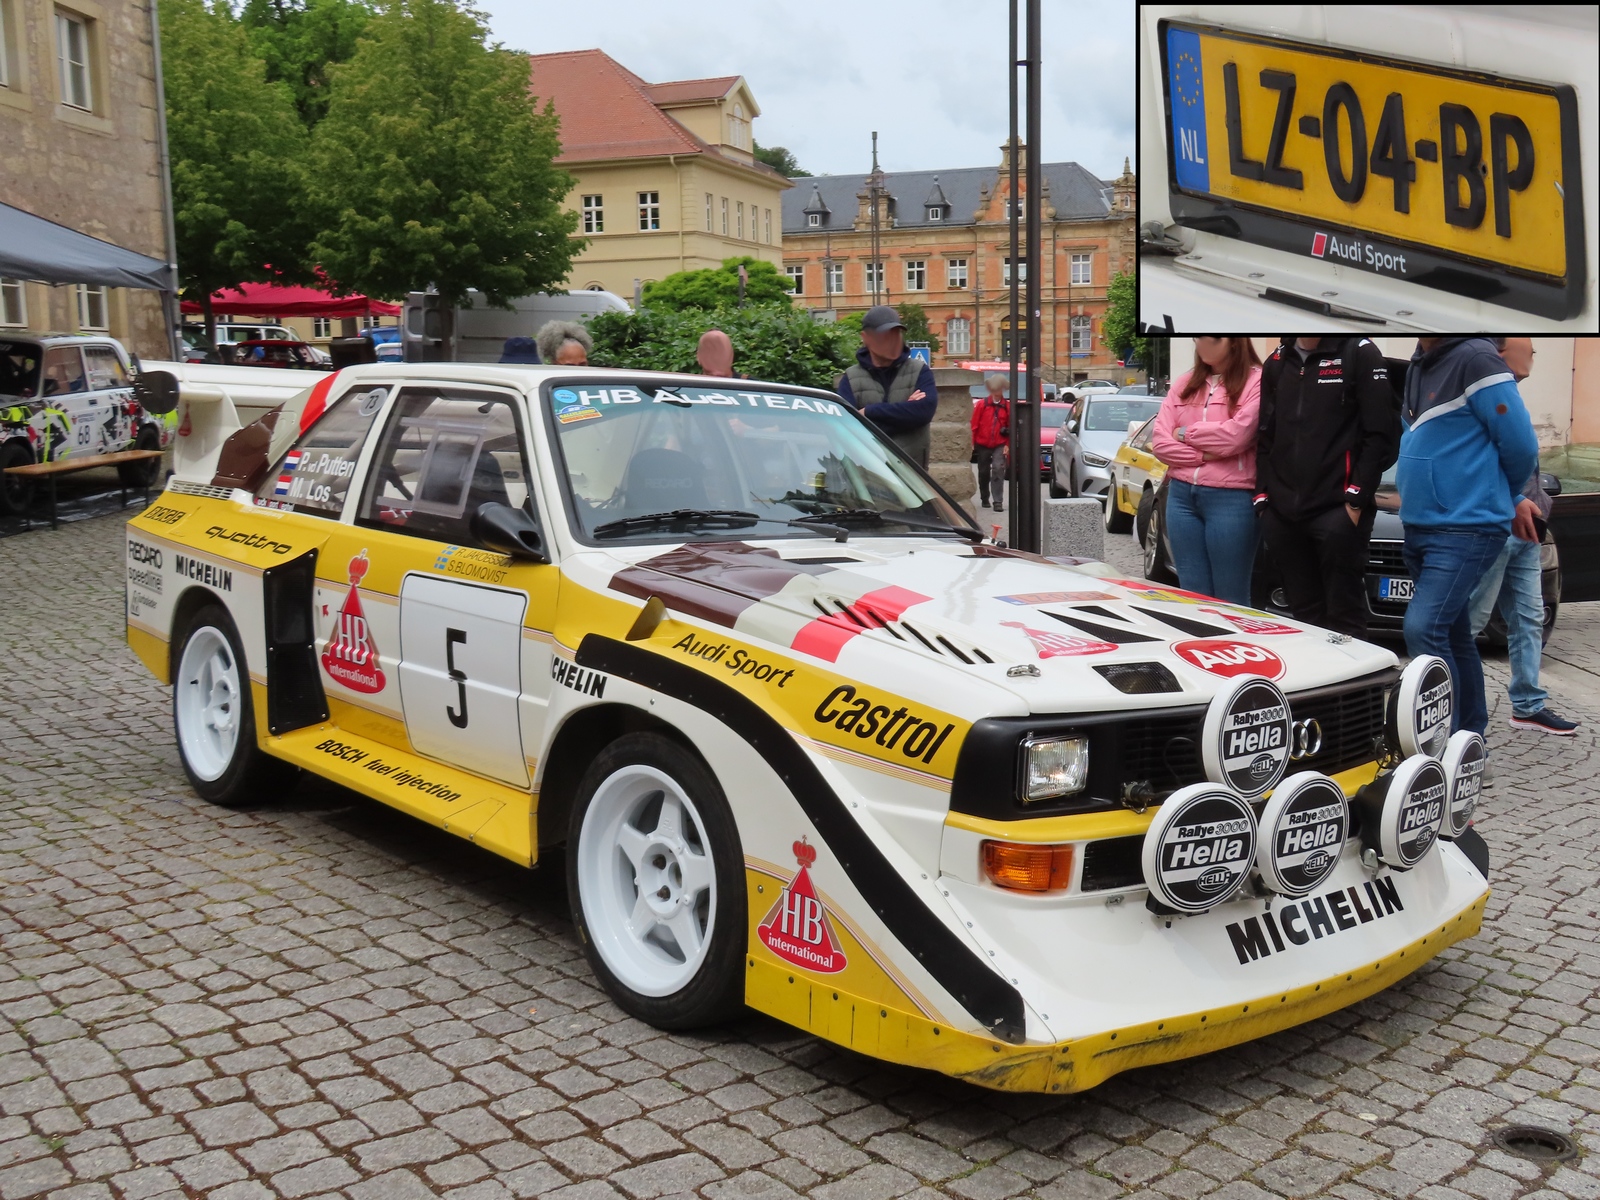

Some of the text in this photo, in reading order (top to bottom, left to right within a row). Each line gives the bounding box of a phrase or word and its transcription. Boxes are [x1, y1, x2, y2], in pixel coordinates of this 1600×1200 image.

[1180, 126, 1204, 164] NL
[1223, 62, 1535, 239] LZ-04-BP
[1329, 236, 1406, 273] Audi Sport
[365, 395, 379, 409] 73
[579, 389, 641, 405] HB
[738, 393, 842, 416] TEAM
[78, 425, 90, 445] 68
[298, 452, 312, 471] P.
[316, 454, 356, 477] Putten
[290, 477, 331, 502] M. Los
[205, 525, 292, 554] quattro
[129, 540, 163, 569] RECARO
[176, 555, 232, 592] MICHELIN
[447, 560, 507, 583] S.BLOMQVIST
[337, 611, 368, 665] HB
[1037, 634, 1087, 649] HB
[329, 661, 378, 688] international
[672, 633, 795, 688] Audi Sport
[446, 627, 468, 729] 5
[814, 684, 955, 765] Castrol
[1233, 706, 1284, 726] Rallye 3000
[1420, 698, 1449, 731] Hella
[1229, 725, 1282, 756] Hella
[315, 739, 461, 802] BOSCH fuel injection
[1250, 758, 1275, 773] HELLA
[1410, 785, 1444, 804] Rallye 3000
[1455, 775, 1481, 799] Hella
[1178, 819, 1249, 839] Rallye 3000
[1289, 804, 1342, 826] Rallye 3000
[1403, 801, 1440, 830] Hella
[1170, 838, 1243, 868] Hella
[1282, 823, 1339, 854] Hella
[1304, 854, 1330, 870] HELLA
[1199, 870, 1232, 885] HELLA
[781, 886, 824, 945] HB
[1225, 875, 1404, 965] MICHELIN
[768, 933, 833, 968] international
